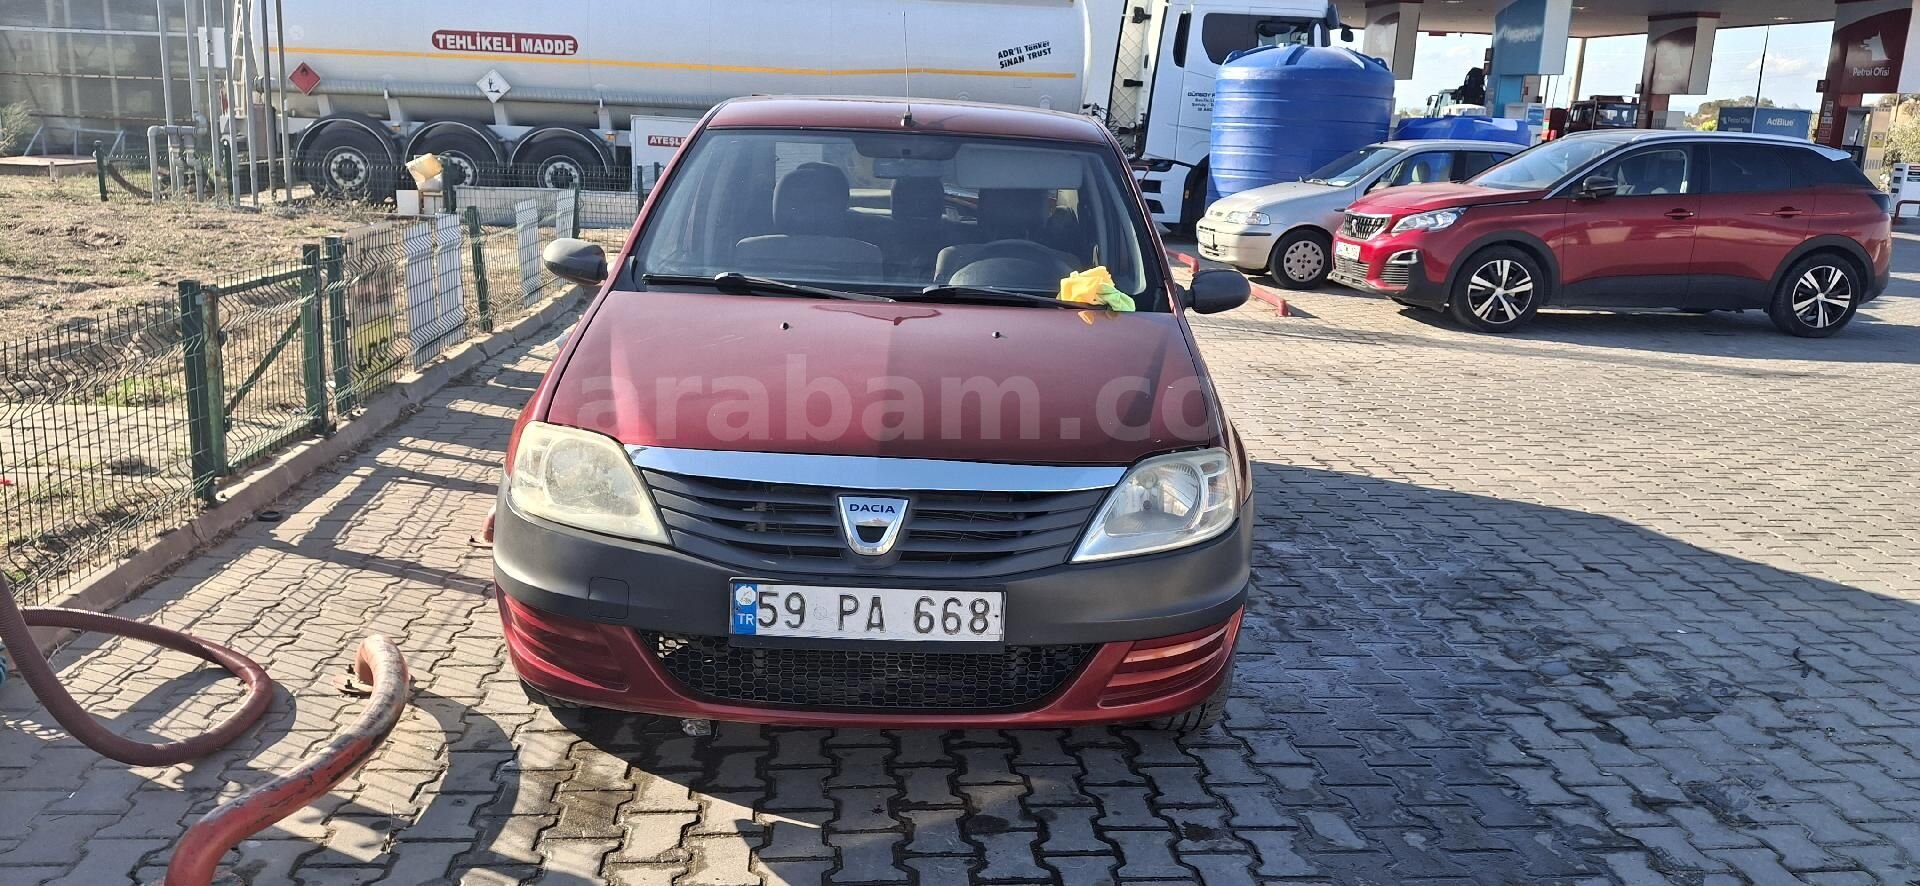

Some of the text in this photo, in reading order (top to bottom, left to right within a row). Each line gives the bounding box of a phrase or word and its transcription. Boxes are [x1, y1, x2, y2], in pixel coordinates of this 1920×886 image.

[436, 32, 574, 54] TEHLİKELİ MADDE
[998, 46, 1022, 59] ADR'li
[1027, 47, 1051, 60] TRUST
[1766, 117, 1794, 127] AdBlue
[849, 503, 895, 514] DACIA
[737, 613, 754, 625] TR
[758, 592, 990, 635] 59 PA 668
